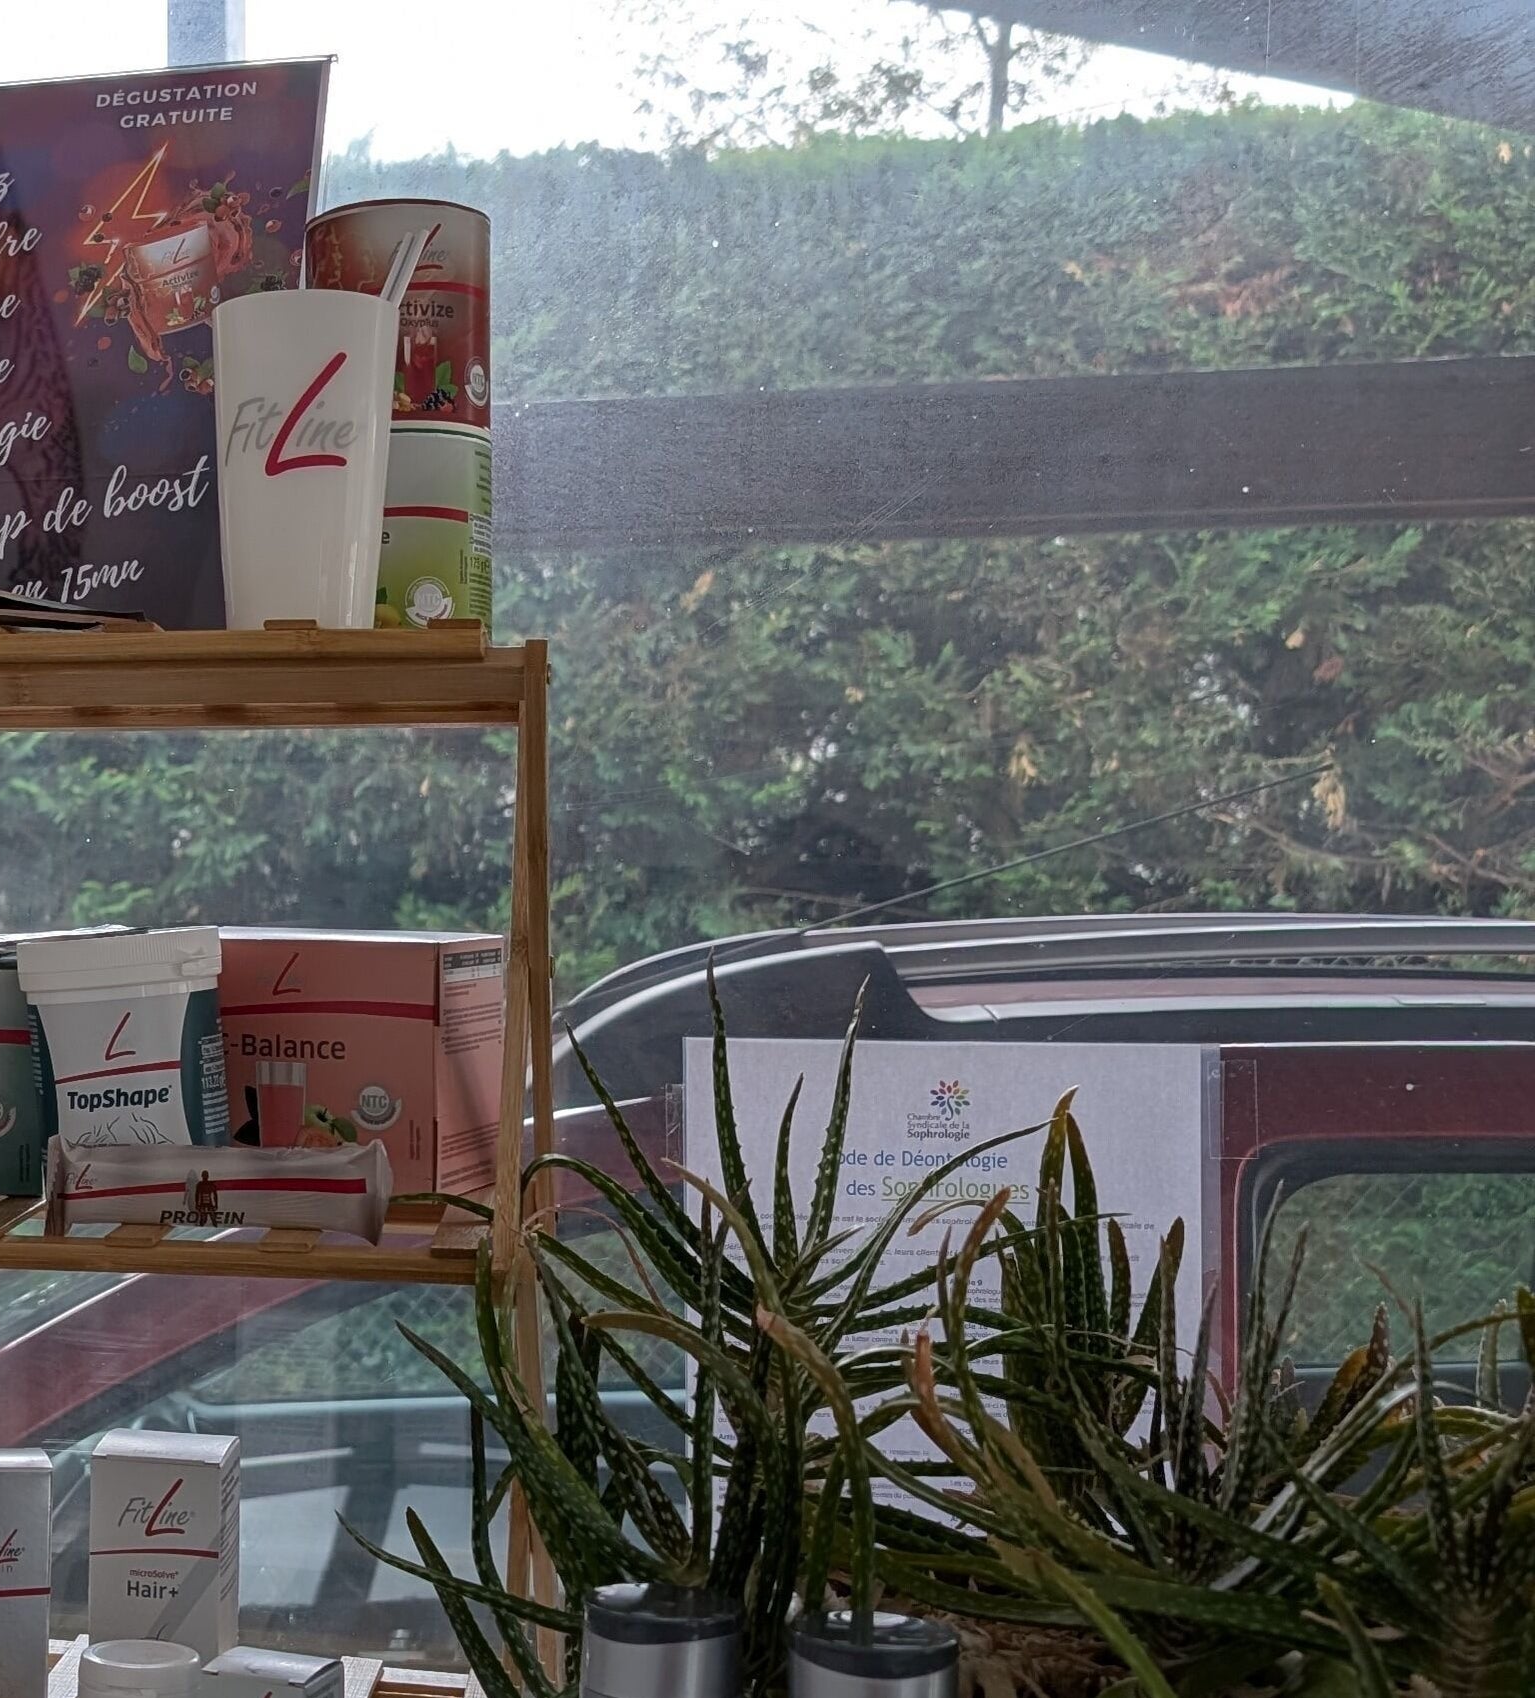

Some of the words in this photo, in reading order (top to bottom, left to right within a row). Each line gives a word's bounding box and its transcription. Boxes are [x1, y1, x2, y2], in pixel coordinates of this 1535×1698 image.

[96, 81, 258, 108] DÉGUSTATION
[119, 107, 233, 129] GRATUITE
[225, 352, 359, 477] FitLine
[42, 486, 93, 534] de
[103, 454, 212, 519] boost
[60, 557, 146, 604] 15mn
[67, 1086, 170, 1112] TopShape
[361, 1093, 387, 1109] NTC
[907, 1113, 941, 1121] Chambre
[907, 1121, 947, 1131] Syndicale
[949, 1122, 961, 1130] de
[964, 1122, 970, 1130] la
[907, 1129, 970, 1142] Sophrologie
[873, 1150, 895, 1166] de
[846, 1180, 876, 1197] des
[159, 1210, 245, 1226] PROTEIN
[117, 1478, 191, 1537] FitLine
[127, 1581, 179, 1600] Hair+
